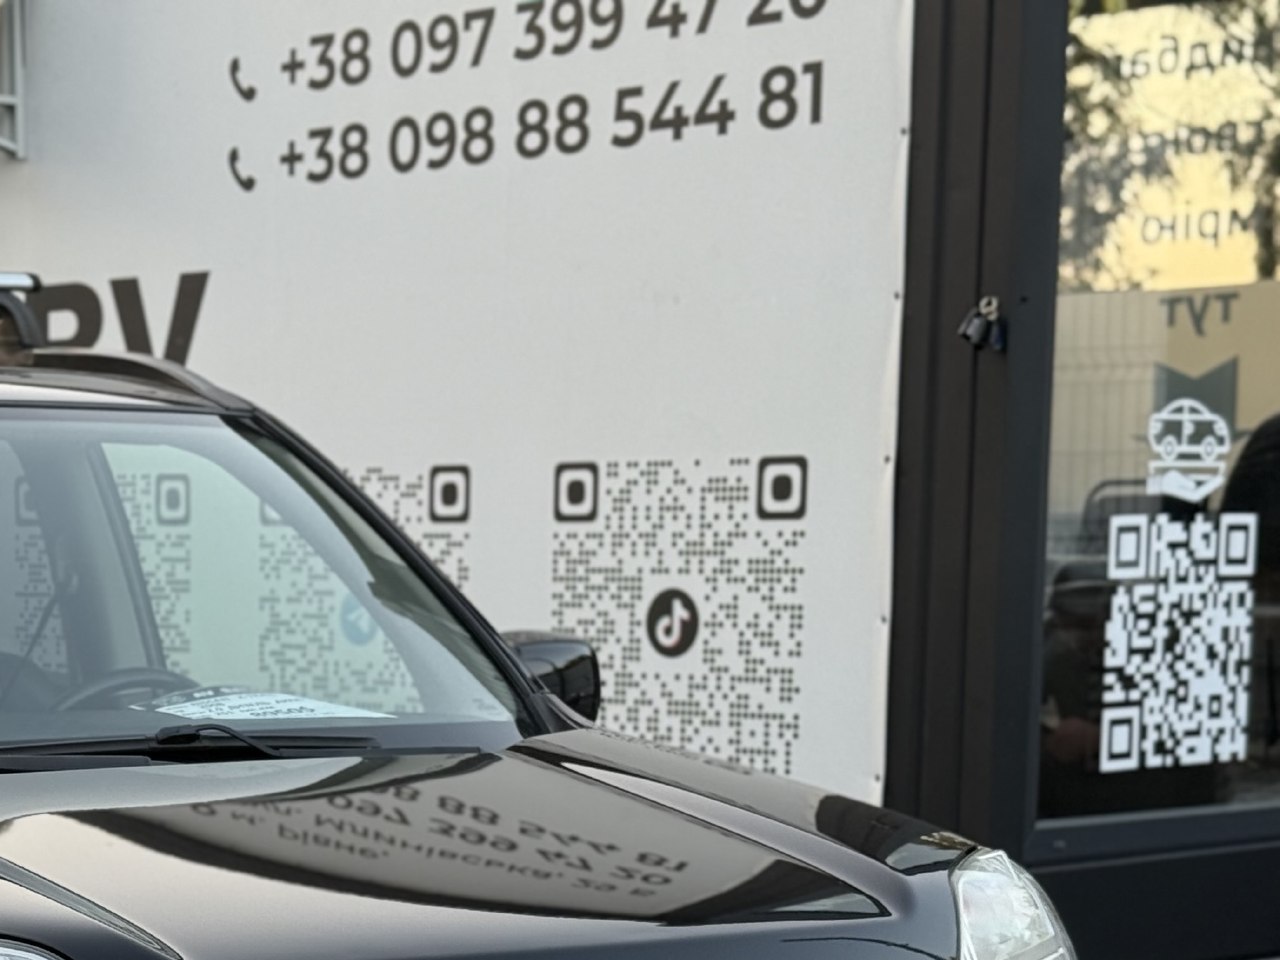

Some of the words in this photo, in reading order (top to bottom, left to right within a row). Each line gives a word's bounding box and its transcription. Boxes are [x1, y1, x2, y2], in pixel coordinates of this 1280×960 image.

[280, 27, 372, 91] +38
[390, 7, 496, 79] 097
[513, 0, 625, 61] 399
[279, 122, 370, 183] +38
[388, 105, 495, 175] 098
[514, 93, 591, 160] 88
[610, 72, 737, 149] 544
[757, 59, 824, 131] 81
